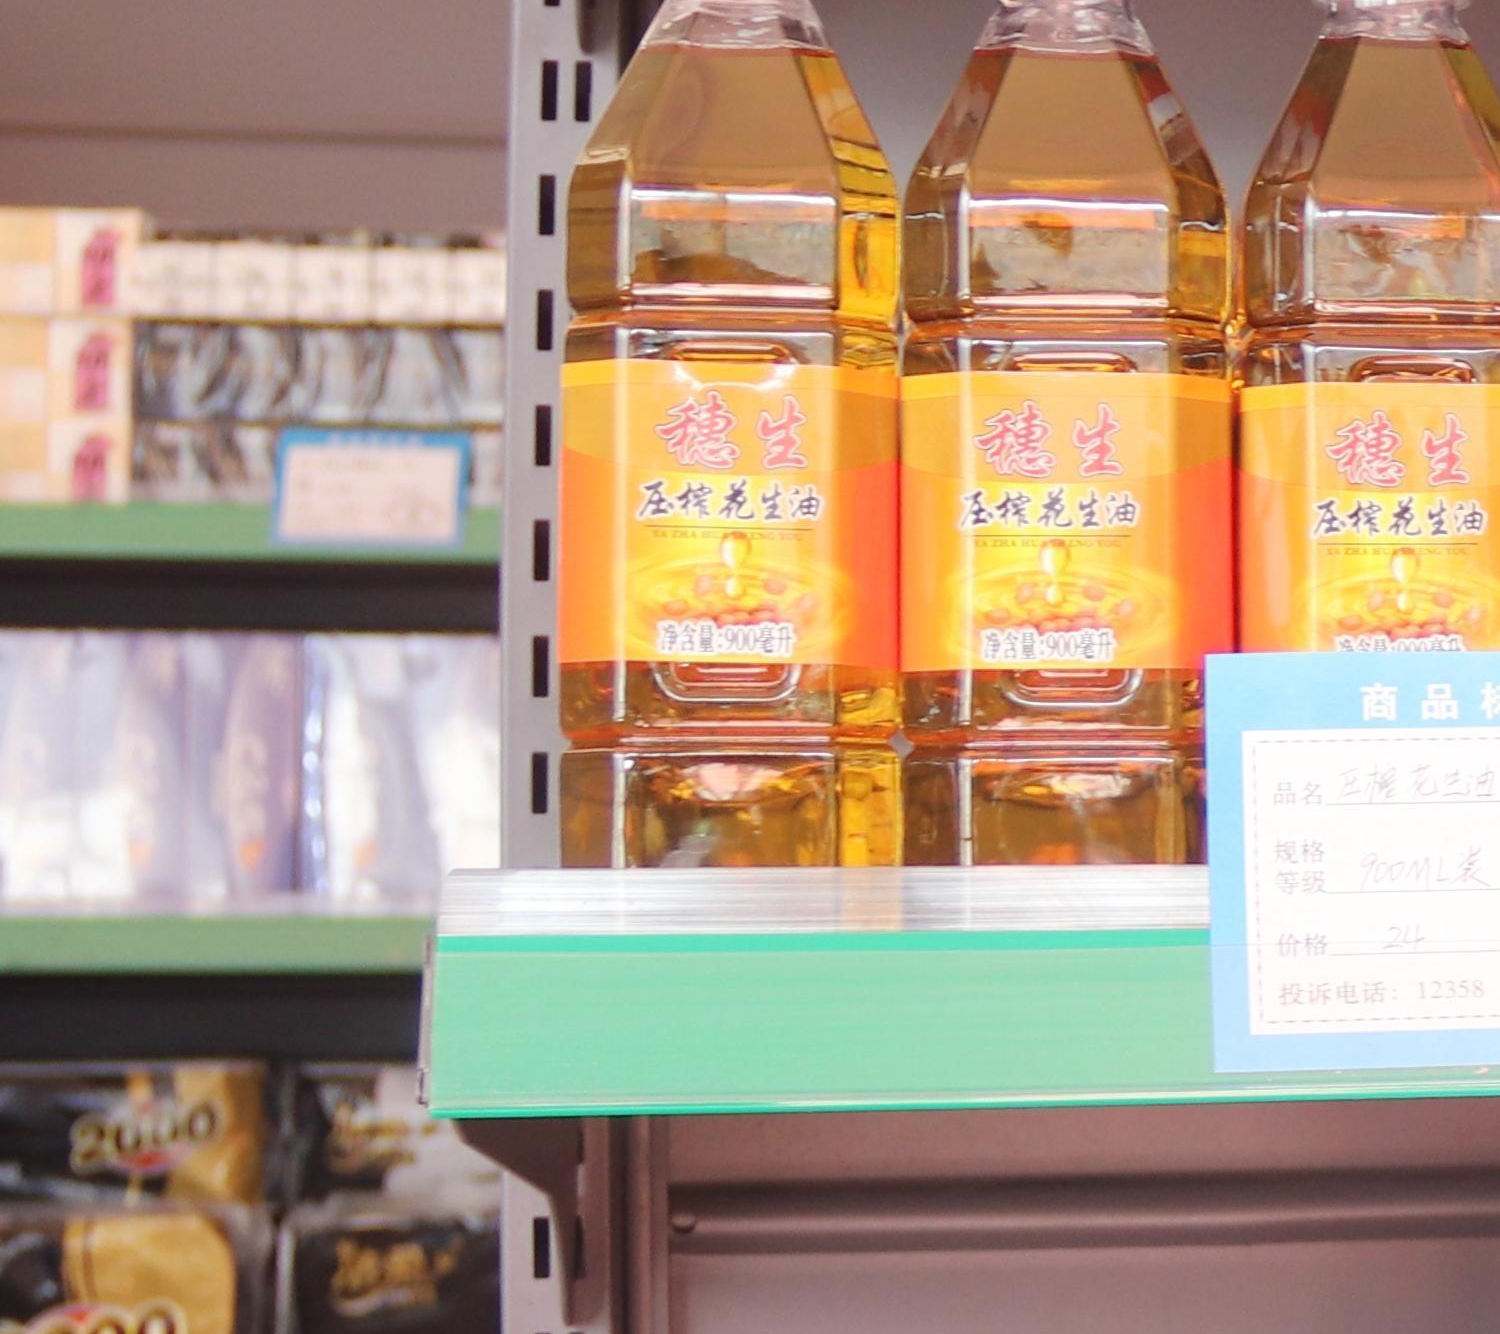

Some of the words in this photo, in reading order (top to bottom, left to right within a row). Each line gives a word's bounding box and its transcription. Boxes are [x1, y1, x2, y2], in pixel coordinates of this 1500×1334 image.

[656, 391, 809, 468] 穗生
[973, 401, 1125, 477] 穗生
[1325, 411, 1470, 487] 穗生
[638, 480, 823, 520] 压榨花生油
[959, 488, 1140, 530] 压榨花生油
[1311, 497, 1488, 539] 压榨花生油
[1272, 782, 1322, 806] 品名
[1273, 840, 1325, 864] 规格
[1274, 870, 1326, 895] 等级
[1277, 933, 1327, 958] 价格
[1417, 981, 1485, 1002] 12358
[75, 1106, 216, 1162] 2000
